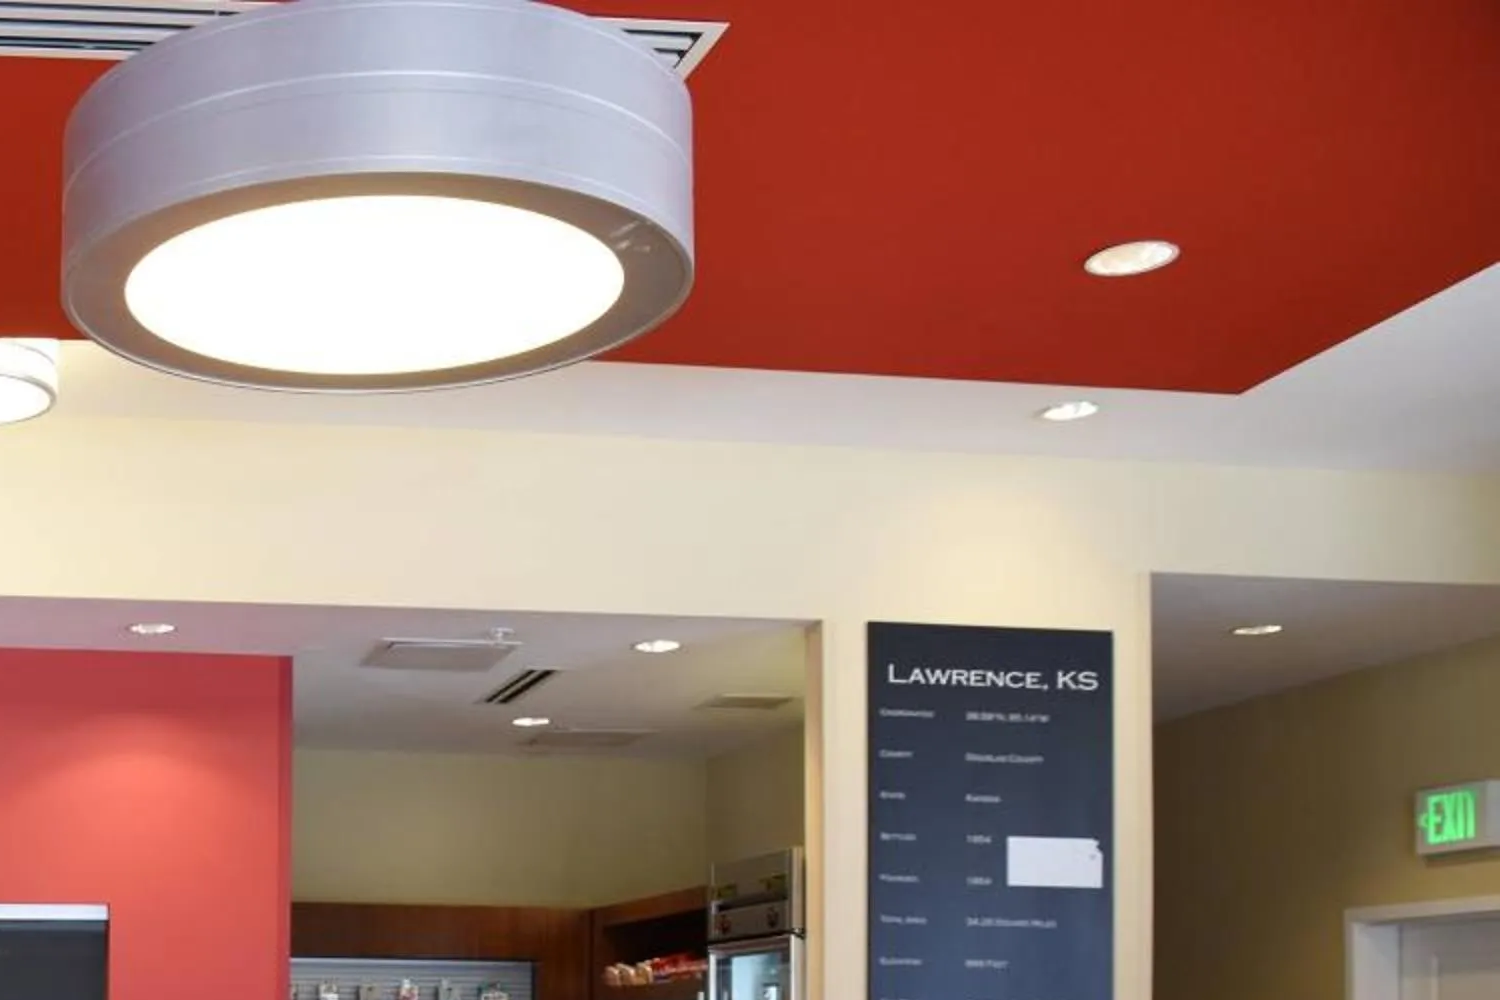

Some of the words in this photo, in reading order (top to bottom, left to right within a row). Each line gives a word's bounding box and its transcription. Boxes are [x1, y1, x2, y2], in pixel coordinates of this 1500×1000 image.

[888, 664, 1049, 690] LAWRENCE,
[1057, 670, 1099, 690] KS
[1427, 790, 1476, 845] EXIT
